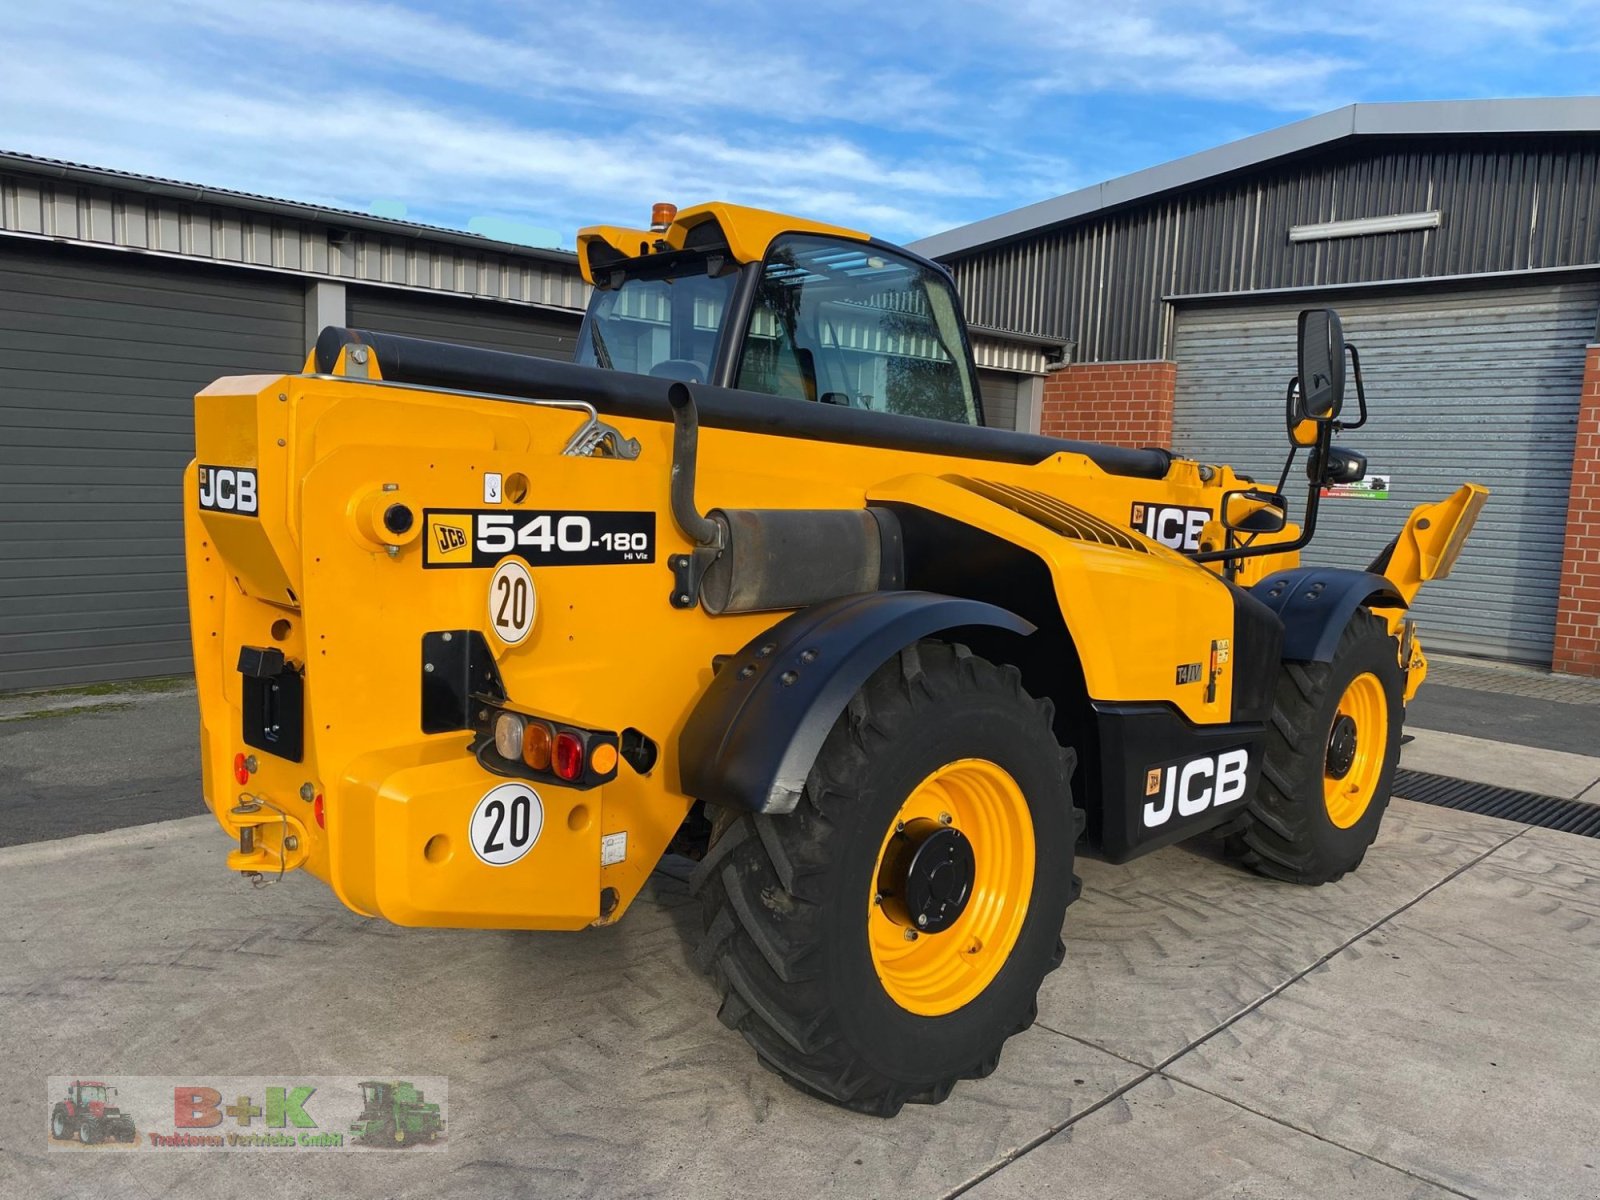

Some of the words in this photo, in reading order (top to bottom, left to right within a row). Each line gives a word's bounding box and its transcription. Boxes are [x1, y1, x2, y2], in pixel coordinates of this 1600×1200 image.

[200, 469, 257, 512] JCB
[438, 526, 466, 551] JCB
[476, 514, 648, 553] 540-180
[624, 552, 633, 560] Hi
[635, 552, 648, 560] Viz
[496, 575, 527, 630] 20
[1143, 748, 1249, 828] JCB
[483, 795, 530, 854] 20
